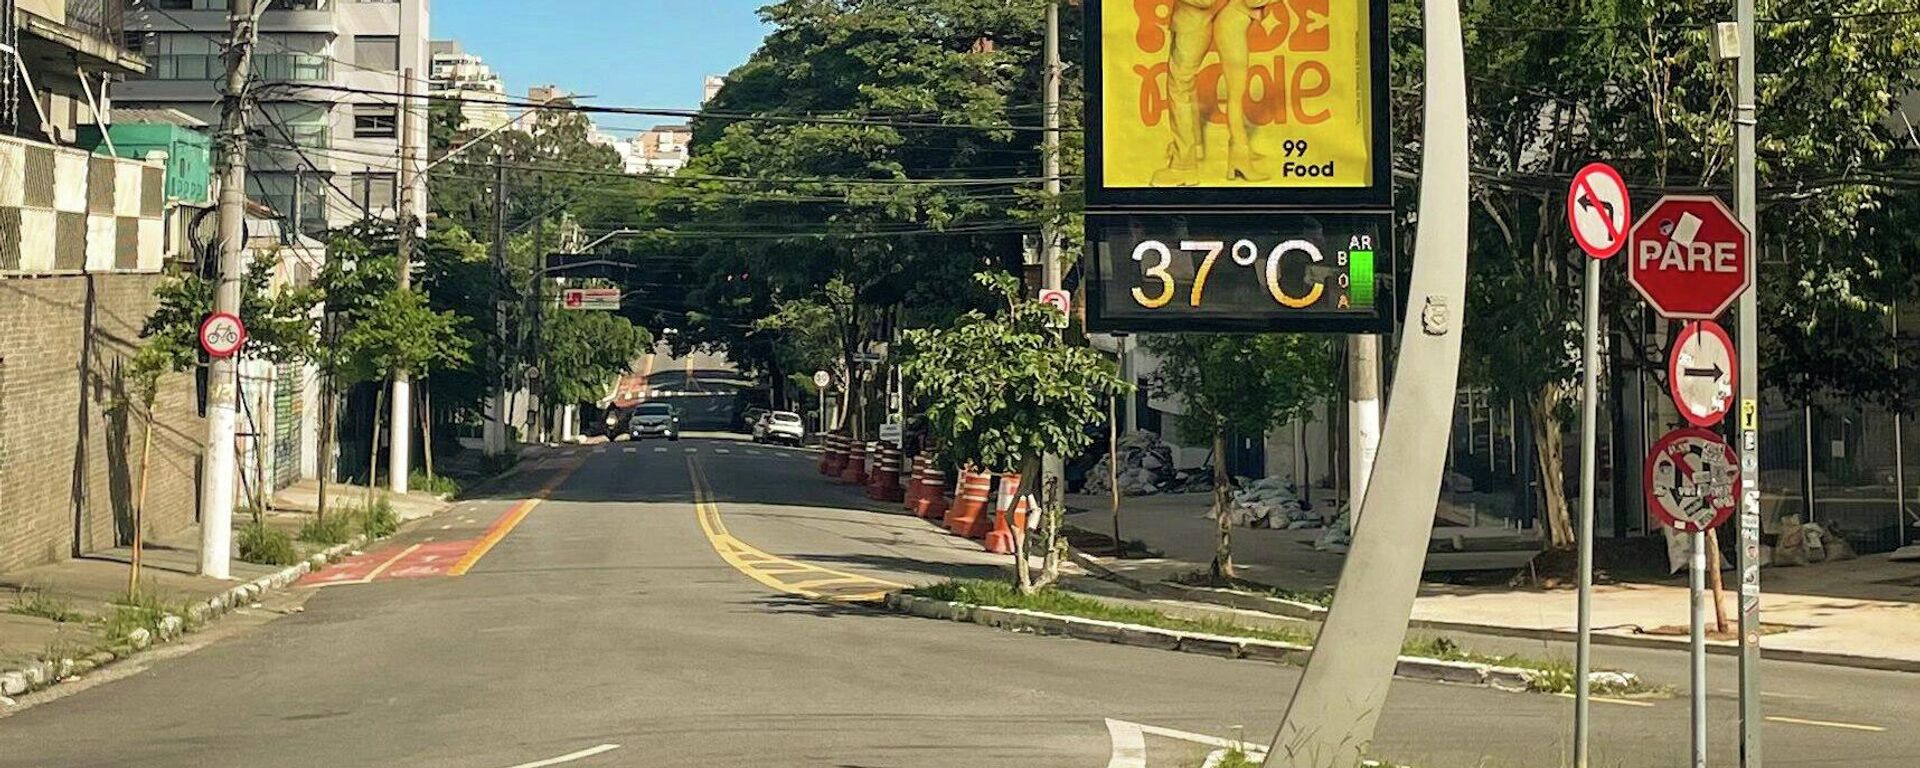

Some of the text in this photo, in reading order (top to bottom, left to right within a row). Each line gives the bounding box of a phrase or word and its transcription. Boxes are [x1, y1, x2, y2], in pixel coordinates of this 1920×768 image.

[1283, 140, 1308, 157] 99
[1283, 161, 1334, 177] Food
[1349, 235, 1372, 250] AR
[1639, 239, 1738, 272] PARE
[1132, 239, 1324, 308] 37°C
